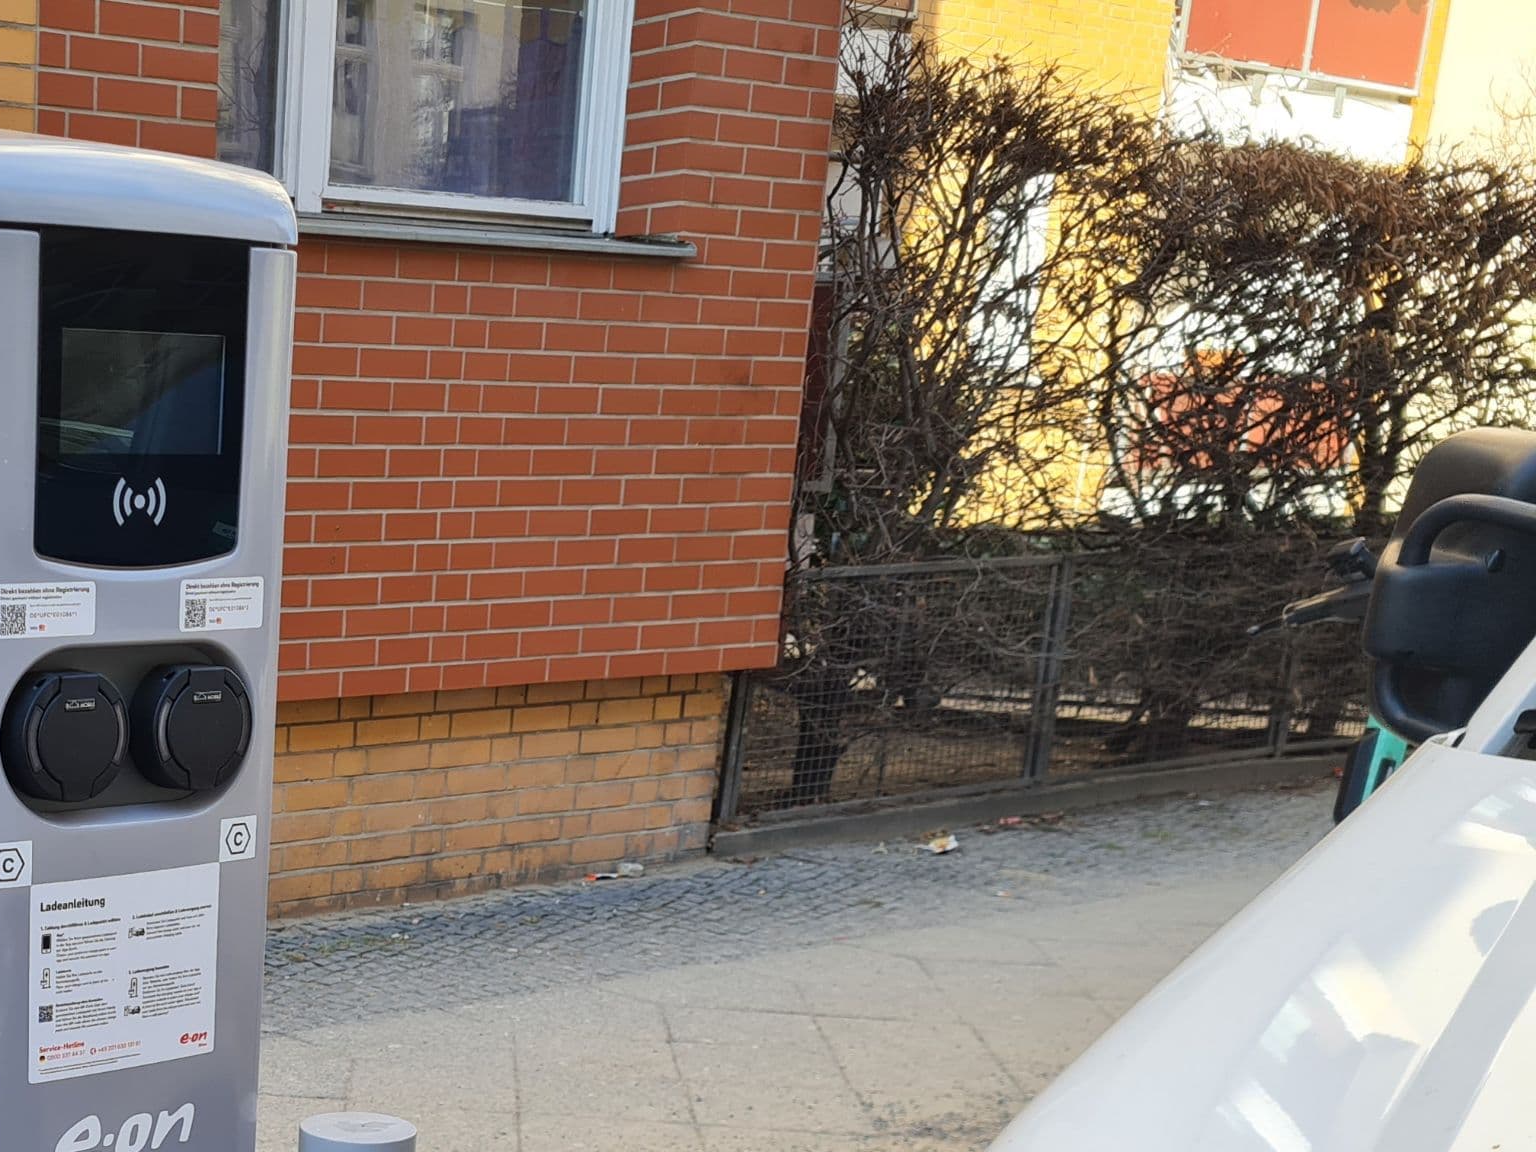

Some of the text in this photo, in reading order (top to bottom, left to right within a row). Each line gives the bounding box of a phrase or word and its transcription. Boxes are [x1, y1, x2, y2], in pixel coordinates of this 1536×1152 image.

[233, 832, 243, 846] C
[2, 858, 15, 873] C
[40, 897, 106, 912] Ladeanleitung
[39, 1041, 85, 1053] Service-Hotline
